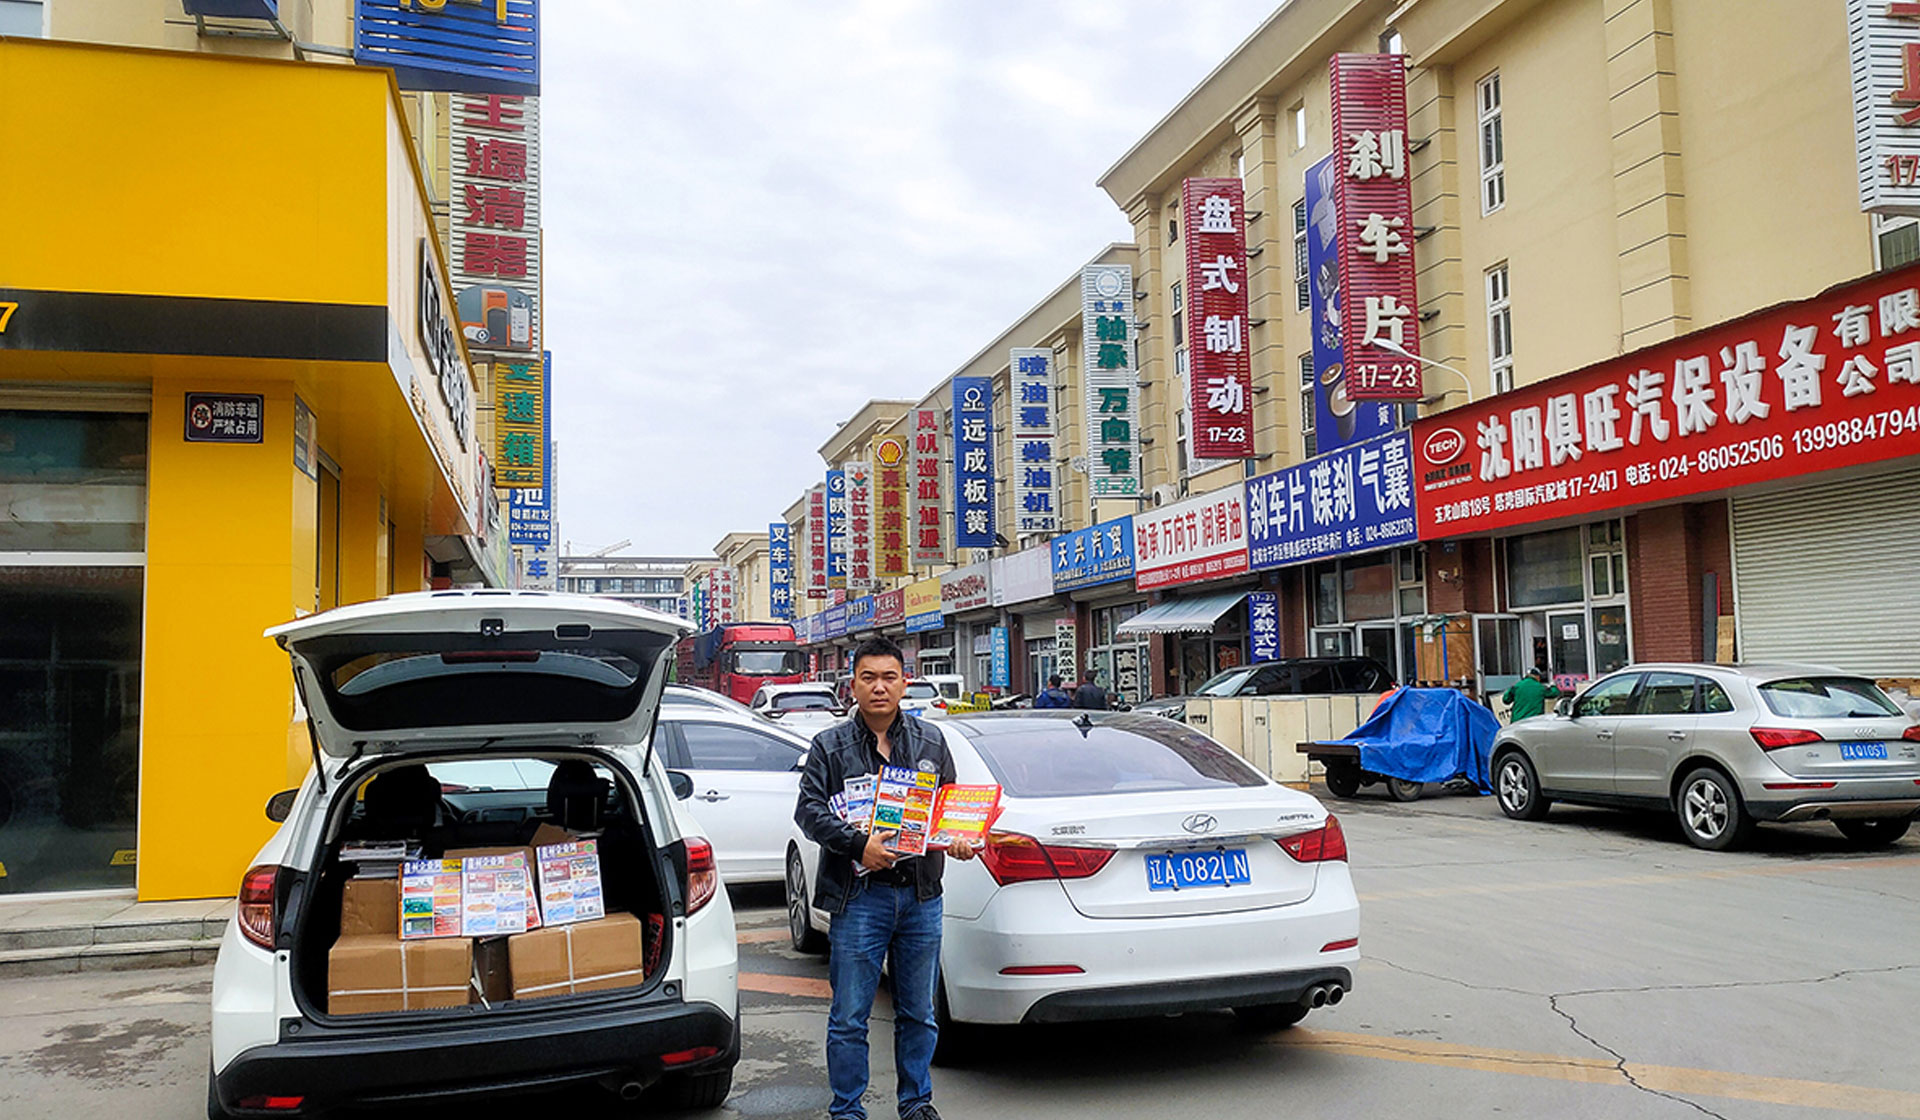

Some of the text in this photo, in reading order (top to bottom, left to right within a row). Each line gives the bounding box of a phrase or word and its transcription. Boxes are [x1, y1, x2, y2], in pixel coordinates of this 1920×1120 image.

[1348, 129, 1411, 348] 刹车片
[1198, 195, 1245, 415] 盘式制动
[1358, 365, 1417, 388] 17-23
[212, 401, 258, 418] 消防车道
[1476, 324, 1827, 482] 沈阳俱旺汽保设备
[211, 419, 257, 435] 严禁占用
[1207, 427, 1246, 443] 17-23
[1429, 438, 1457, 454] TECH
[962, 418, 988, 534] 远成板簧
[1096, 478, 1137, 496] 17-22
[1434, 496, 1492, 524] 玉龙山路18号
[771, 527, 789, 605] 叉车配件
